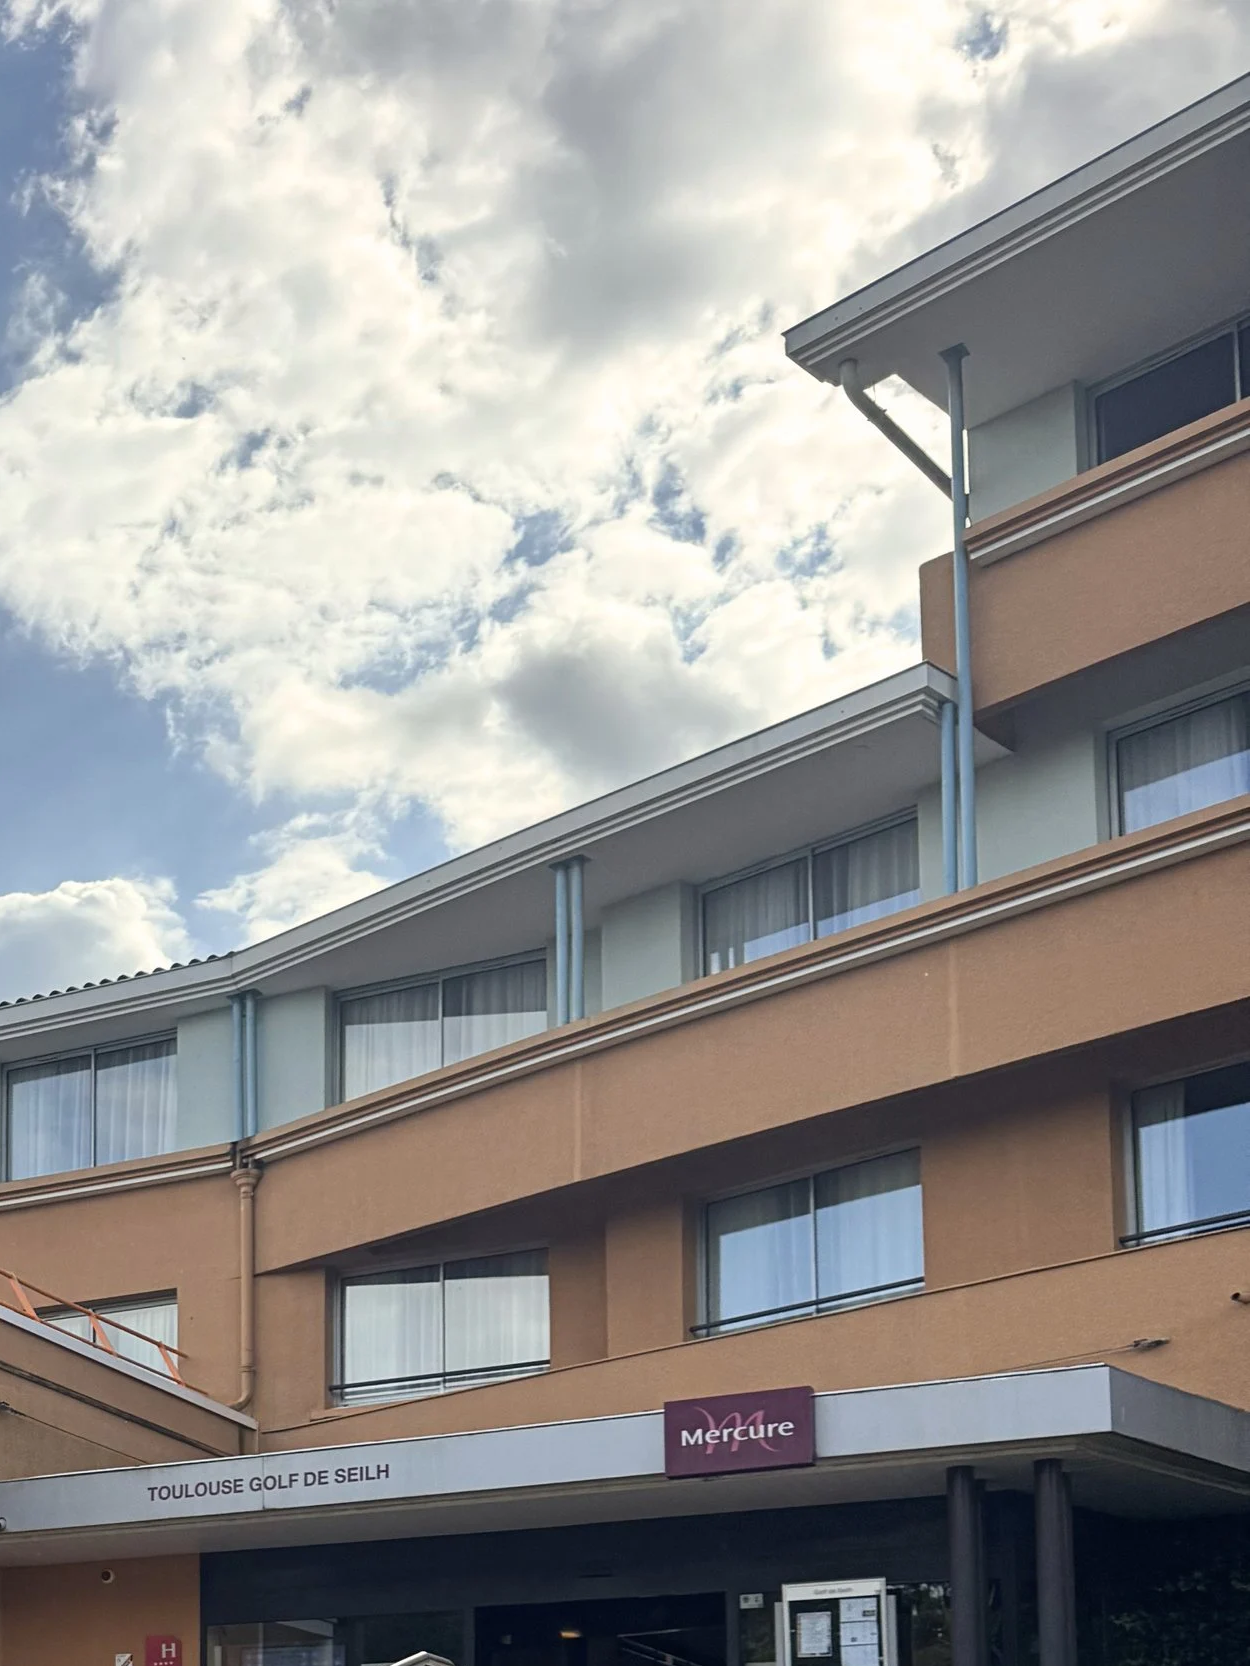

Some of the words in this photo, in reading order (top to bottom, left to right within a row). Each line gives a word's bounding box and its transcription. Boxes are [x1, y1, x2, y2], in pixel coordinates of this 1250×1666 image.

[680, 1420, 795, 1447] Mercure
[147, 1478, 245, 1502] TOULOUSE
[249, 1473, 300, 1492] GOLF
[303, 1470, 329, 1487] DE
[334, 1463, 390, 1484] SEILH
[161, 1642, 176, 1659] H
